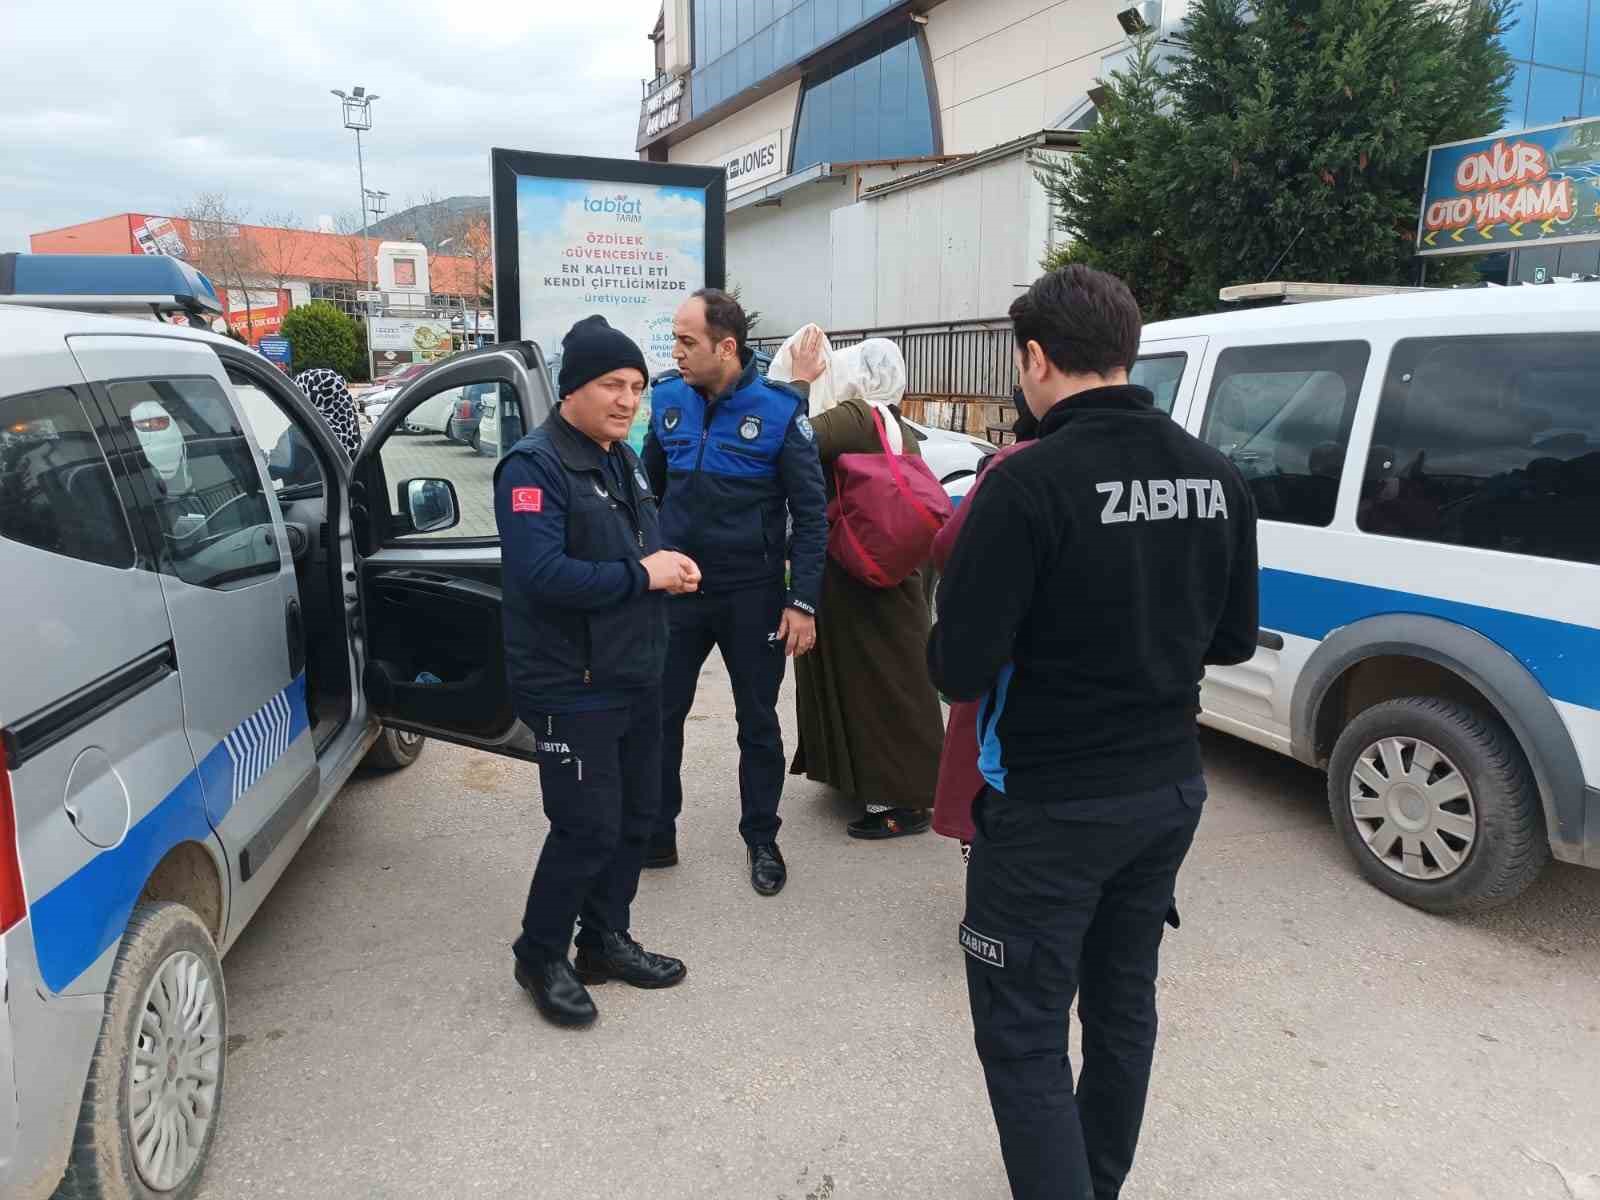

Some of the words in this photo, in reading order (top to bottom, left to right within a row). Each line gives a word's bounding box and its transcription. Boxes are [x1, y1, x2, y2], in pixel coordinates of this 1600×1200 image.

[740, 143, 774, 175] JONES
[1457, 140, 1546, 189] ONUR
[583, 195, 641, 213] tabiat
[1426, 198, 1473, 229] OTO
[1475, 180, 1573, 229] YIKAMA
[586, 232, 644, 245] ÖZDİLEK
[561, 263, 579, 274] EN
[585, 263, 643, 276] KALİTELİ
[648, 266, 669, 277] ETİ
[543, 276, 586, 288] KENDİ
[1095, 478, 1228, 524] ZABITA
[793, 599, 815, 614] ZABITA
[536, 742, 570, 752] ABITA
[961, 930, 997, 960] ZABITA
